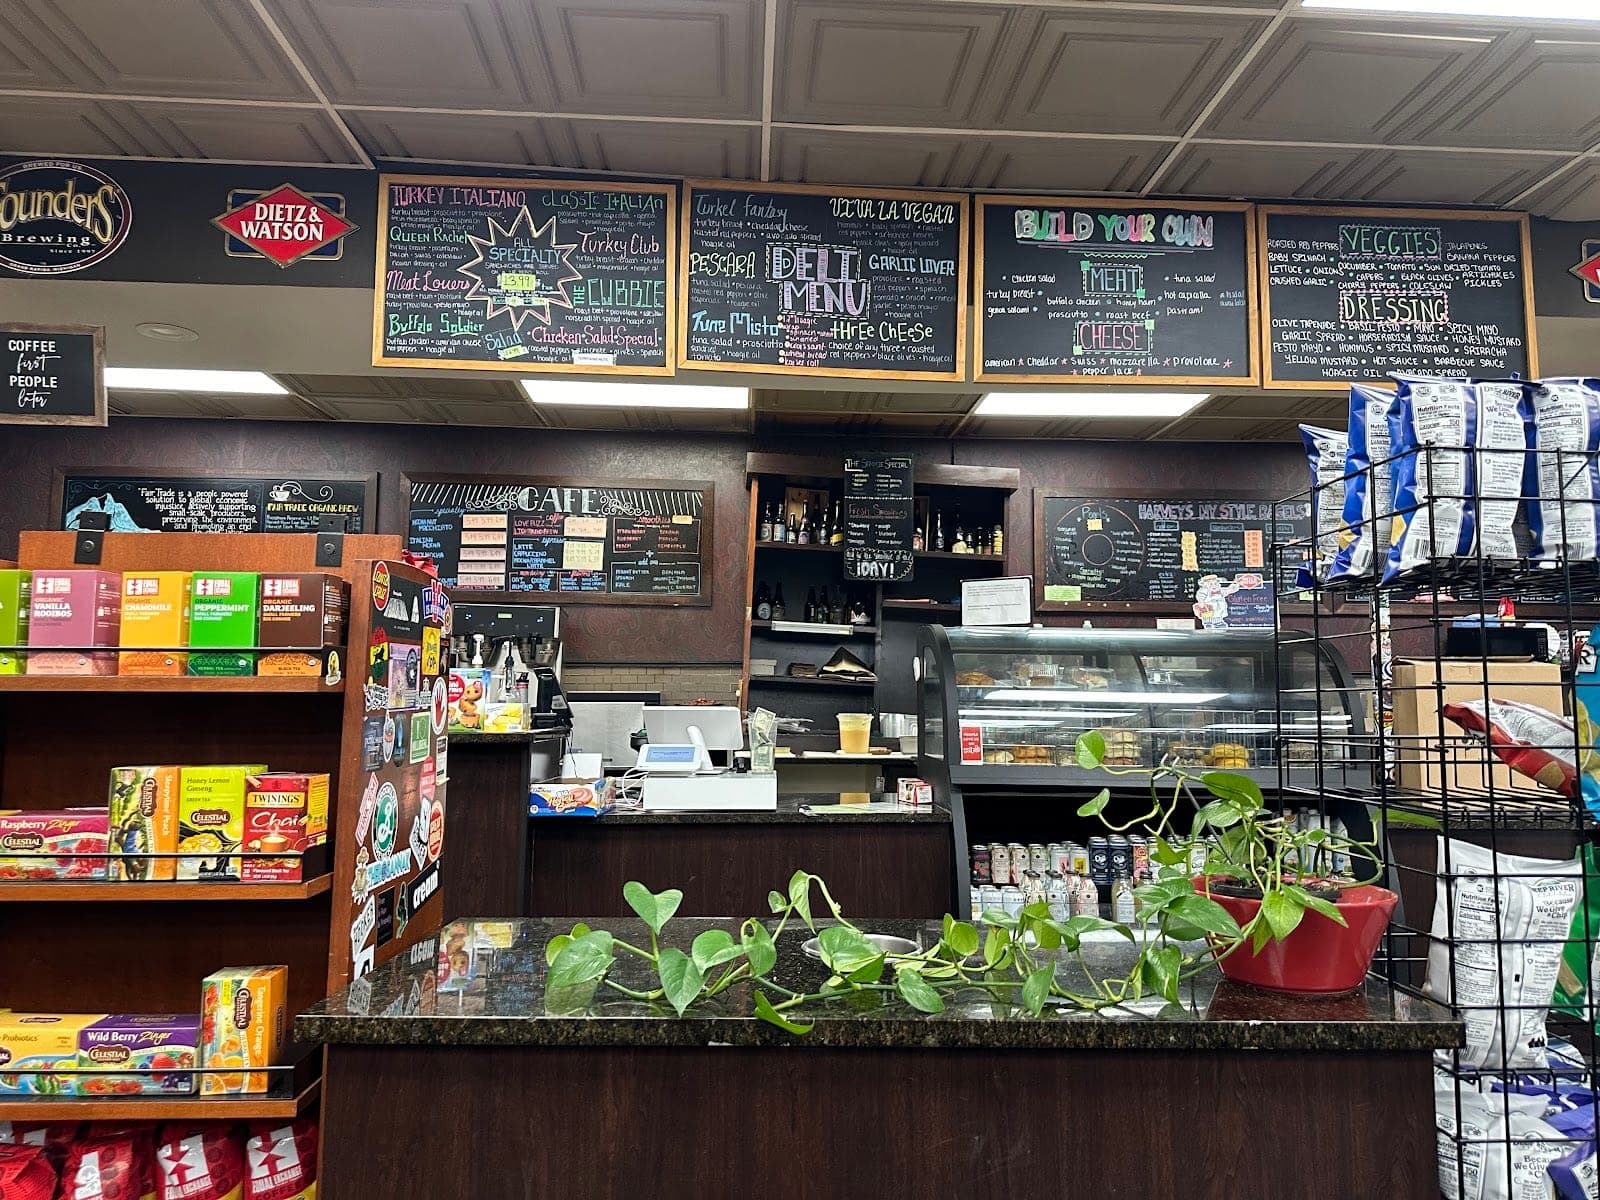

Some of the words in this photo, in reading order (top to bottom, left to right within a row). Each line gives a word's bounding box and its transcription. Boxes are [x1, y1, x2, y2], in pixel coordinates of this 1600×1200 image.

[390, 186, 444, 206] TURKEY
[449, 188, 526, 208] ITALIANO
[254, 203, 307, 222] DIETZ
[308, 206, 323, 222] &
[829, 198, 875, 218] VIVA
[877, 200, 899, 220] LA
[901, 201, 955, 224] VEGAN
[240, 220, 324, 241] WATSON
[751, 221, 781, 231] cheddar
[784, 222, 809, 231] cheese
[1014, 209, 1095, 242] BUILD
[1097, 213, 1156, 243] YOUR
[1161, 214, 1214, 247] OWN
[2, 233, 91, 246] Brewing
[390, 226, 430, 242] QUEEN
[514, 237, 535, 248] ALL
[576, 230, 627, 259] Turkey
[630, 233, 660, 255] Club
[1342, 227, 1437, 255] VEGGIES
[489, 247, 561, 264] SPECIALTY
[1268, 251, 1289, 262] BABY
[1291, 252, 1327, 262] SPINACH
[1446, 252, 1480, 262] BANANA
[1483, 253, 1517, 263] PEPPERS
[689, 251, 756, 279] PESCARA
[773, 247, 857, 284] DELI
[868, 254, 916, 273] GARLIC
[919, 257, 956, 277] LOVER
[1269, 264, 1302, 274] LETTUCE
[387, 270, 420, 291] Meat
[422, 271, 471, 291] Lovers
[1090, 267, 1139, 292] MEAT
[1173, 273, 1192, 283] tuna
[1194, 272, 1216, 283] salad
[1463, 279, 1503, 288] PICKLES
[573, 285, 586, 306] THE
[587, 279, 665, 307] CUBBIE
[783, 280, 866, 316] MENU
[986, 289, 1010, 302] turkey
[1163, 290, 1176, 300] hot
[1048, 310, 1089, 320] prosciutto
[1105, 311, 1128, 320] roast
[1166, 305, 1204, 317] pastrami
[1343, 295, 1445, 322] DRESSING
[729, 312, 779, 336] Misto
[1348, 321, 1376, 333] BASIL
[1446, 322, 1473, 336] SPICY
[1475, 324, 1499, 336] MAYO
[531, 326, 582, 345] Chicken
[583, 325, 614, 345] Salad
[616, 325, 659, 350] Special
[742, 338, 784, 348] prosciutto
[1079, 323, 1143, 350] CHEESE
[1281, 331, 1312, 342] GARLIC
[1315, 331, 1346, 342] SPREAD
[1452, 334, 1480, 346] HONEY
[1483, 336, 1522, 347] MUSTARD
[8, 339, 57, 352] COFFEE
[880, 343, 901, 352] three
[907, 344, 935, 353] roasted
[1273, 341, 1298, 353] PESTO
[1301, 342, 1324, 354] MAYO
[1385, 343, 1412, 353] SPICY
[1412, 344, 1450, 354] MUSTARD
[1463, 345, 1508, 357] SRIRACHA
[17, 353, 62, 374] first
[984, 357, 1016, 367] american
[1109, 356, 1161, 367] mozzarella
[1172, 356, 1221, 367] provolone
[1284, 354, 1318, 365] YELLOW
[1372, 355, 1387, 366] HOT
[1321, 368, 1359, 378] HOAGIE
[1363, 369, 1383, 378] OIL
[9, 375, 58, 388] PEOPLE
[18, 388, 52, 409] later
[1539, 405, 1564, 414] Nutrition
[154, 487, 176, 497] Trade
[196, 489, 218, 500] people
[221, 489, 249, 498] powered
[518, 486, 601, 514] CAFE
[145, 496, 175, 504] solution
[178, 496, 187, 504] to
[189, 495, 212, 506] global
[215, 496, 249, 505] economic
[218, 502, 257, 513] supporting
[1219, 503, 1257, 521] STYLE
[161, 516, 199, 527] preserving
[201, 516, 213, 524] the
[173, 521, 188, 530] and
[191, 521, 225, 533] promoting
[238, 521, 252, 532] end
[1252, 593, 1269, 602] Free
[34, 602, 71, 610] VANILLA
[125, 603, 172, 611] CHAMOMILE
[194, 604, 250, 612] PEPPERMINT
[34, 610, 73, 618] ROOIBOS
[187, 777, 208, 785] Honey
[208, 777, 230, 785] Lemon
[186, 785, 213, 793] Ginseng
[144, 778, 156, 815] CELESTIAL
[252, 793, 300, 803] TWININGS
[191, 812, 228, 822] CELESTIAL
[251, 811, 299, 827] Chai
[0, 820, 47, 831] Raspberry
[3, 836, 42, 846] CELESTIAL
[1549, 884, 1575, 892] RIVER
[1461, 893, 1487, 902] Nutrition
[1536, 905, 1548, 913] We
[238, 989, 250, 1026] CELESTIAL
[255, 986, 267, 1026] Tangerine
[2, 1033, 39, 1042] Probiotics
[87, 1031, 110, 1042] Wild
[111, 1031, 138, 1043] Berry
[137, 1031, 174, 1045] Zinger
[90, 1050, 128, 1060] CELESTIAL
[1463, 1165, 1478, 1177] 150
[1513, 1162, 1528, 1170] We
[274, 1164, 304, 1186] EXCHANGE
